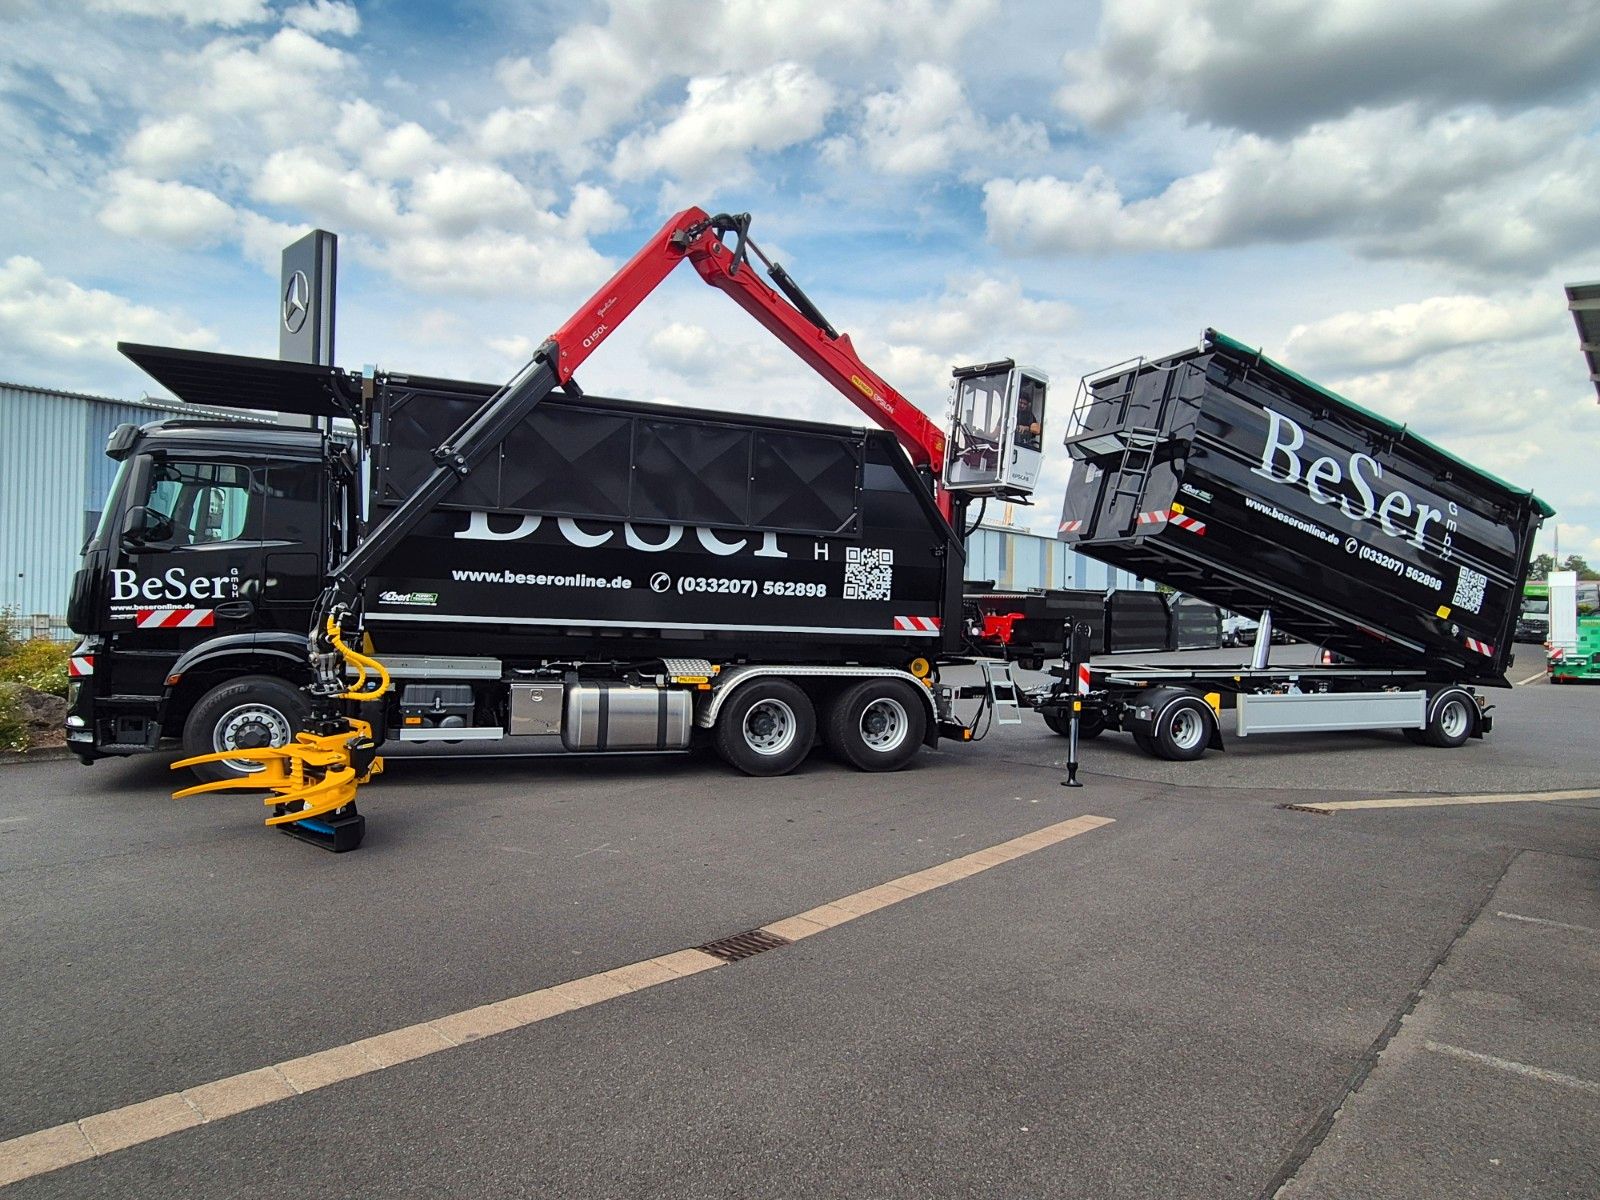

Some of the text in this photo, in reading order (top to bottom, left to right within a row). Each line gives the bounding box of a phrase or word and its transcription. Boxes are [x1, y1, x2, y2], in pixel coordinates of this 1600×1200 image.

[1250, 406, 1442, 551] BeSer
[1245, 497, 1443, 592] www.beseronline.de (033207) 562898
[111, 567, 239, 601] BeSer GmbH
[451, 570, 827, 598] www.beseronline.de (033207) 562898
[110, 603, 196, 611] www.beseronline.de
